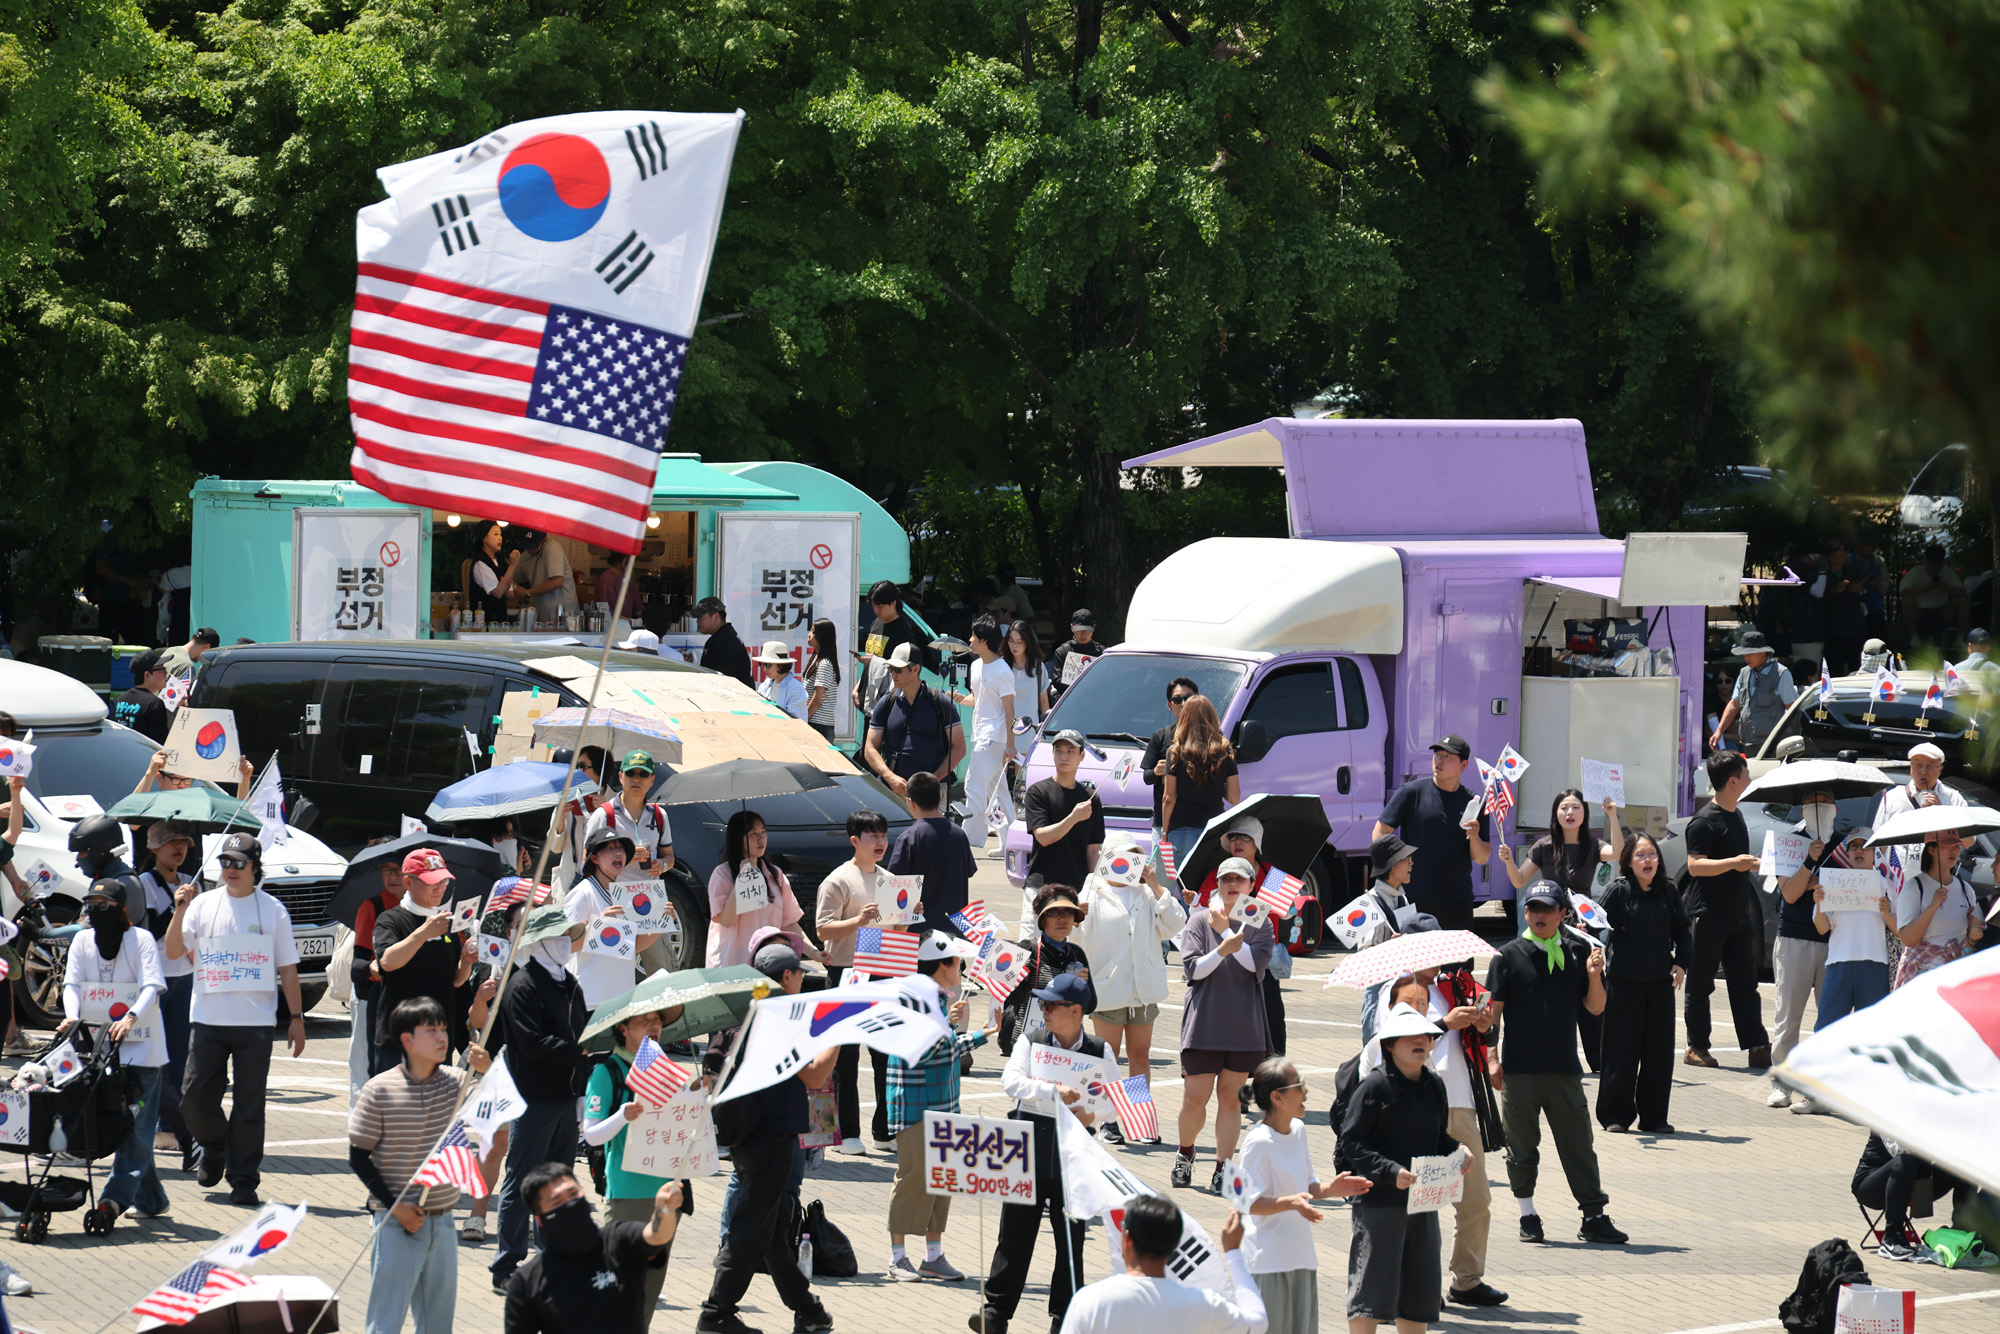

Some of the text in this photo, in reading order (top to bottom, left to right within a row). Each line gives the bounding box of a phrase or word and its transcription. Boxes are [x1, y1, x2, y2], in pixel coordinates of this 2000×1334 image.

[336, 567, 385, 598] 부정
[760, 569, 815, 599] 부정
[335, 601, 384, 630] 선거
[760, 602, 814, 631] 선거
[1776, 834, 1803, 849] STOP
[625, 882, 652, 894] 재선거
[303, 940, 327, 955] 2521
[1034, 1048, 1072, 1066] 부정선거
[930, 1119, 1029, 1173] 부정선거
[966, 1172, 1010, 1196] 900만
